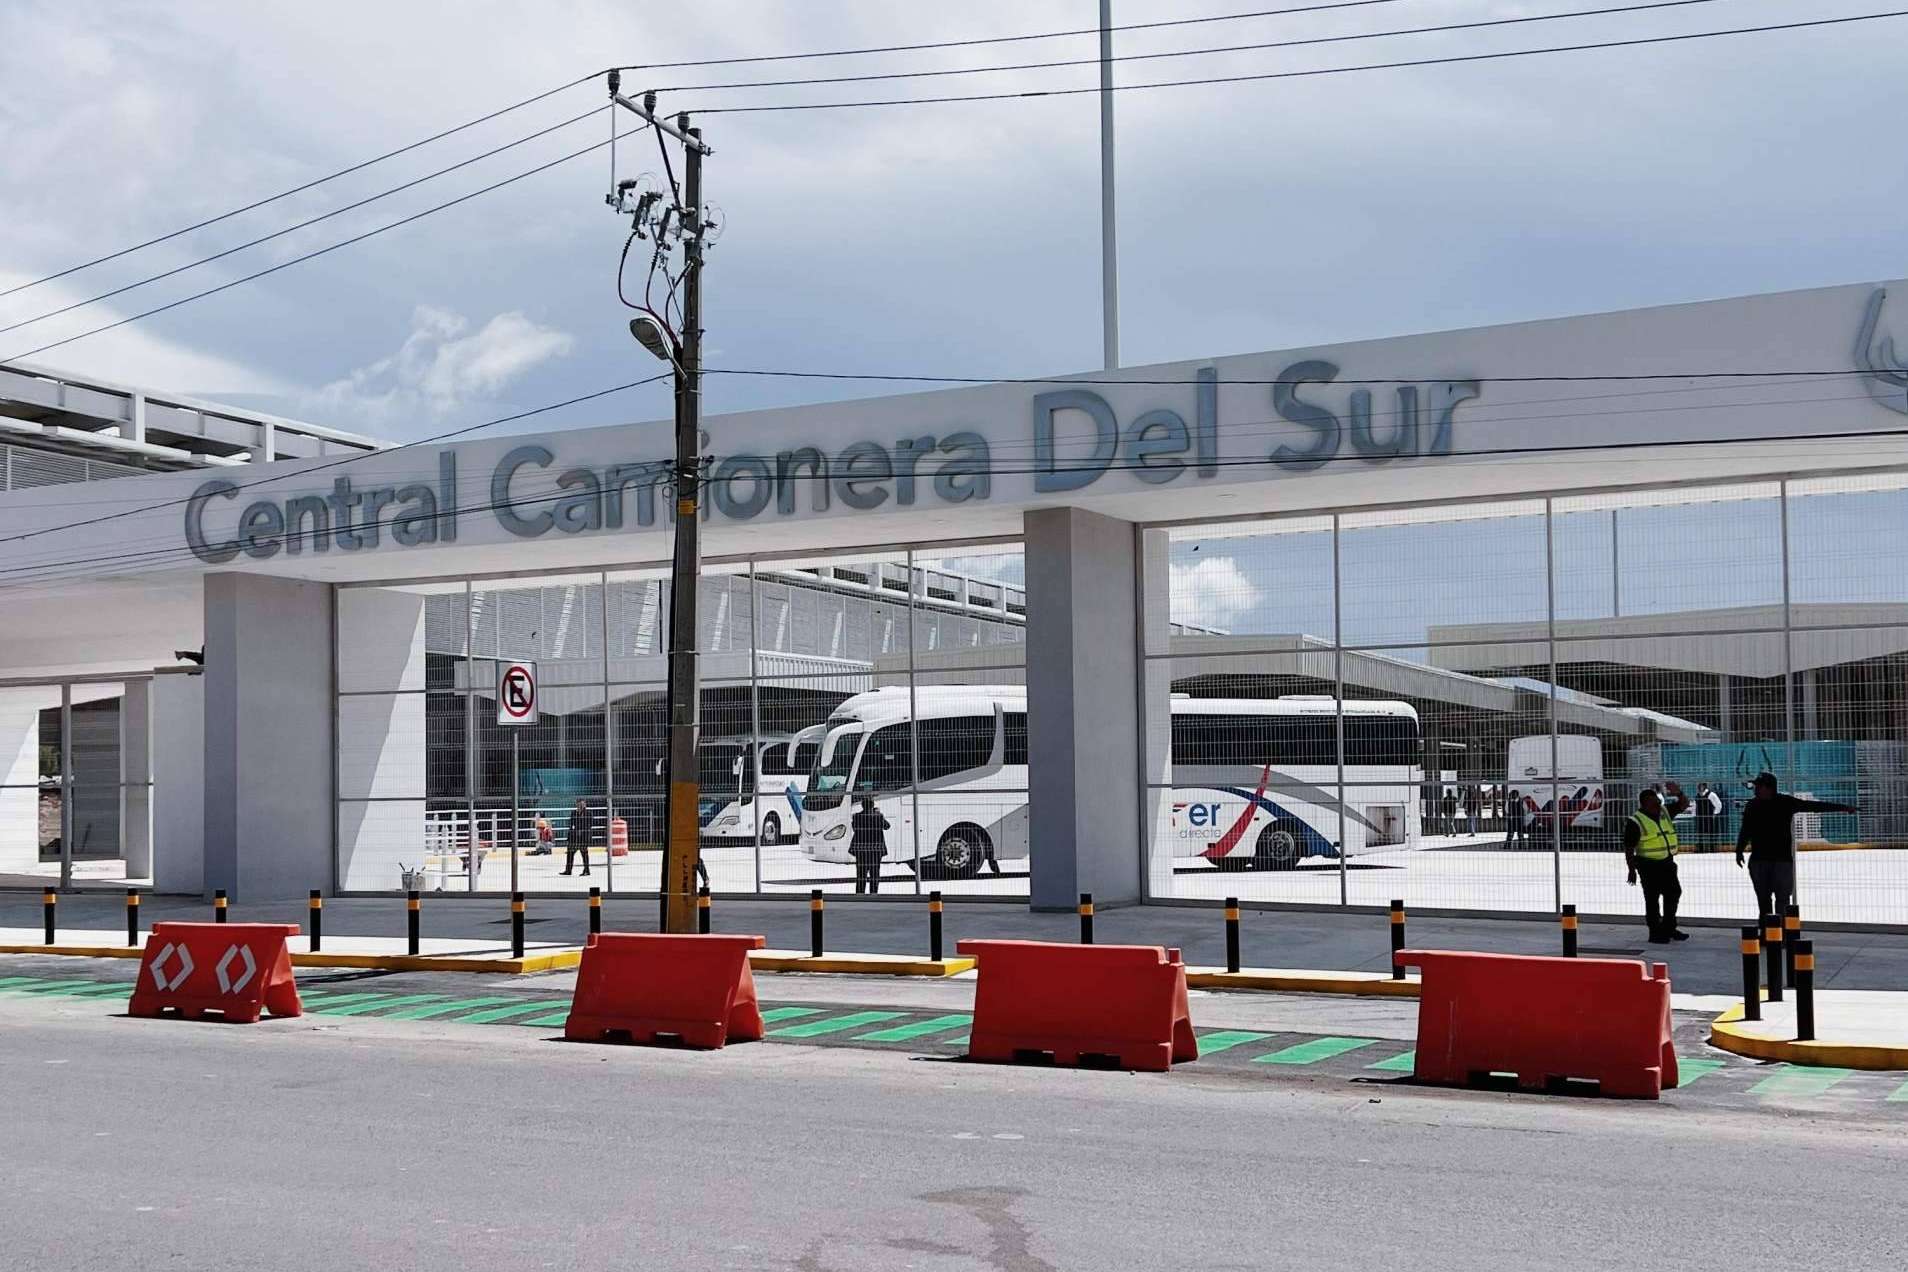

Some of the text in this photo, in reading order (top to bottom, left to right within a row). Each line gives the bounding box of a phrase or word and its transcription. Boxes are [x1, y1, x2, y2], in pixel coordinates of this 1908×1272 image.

[185, 451, 457, 564] Central
[1034, 367, 1218, 493] Del
[1269, 360, 1480, 472] Sur
